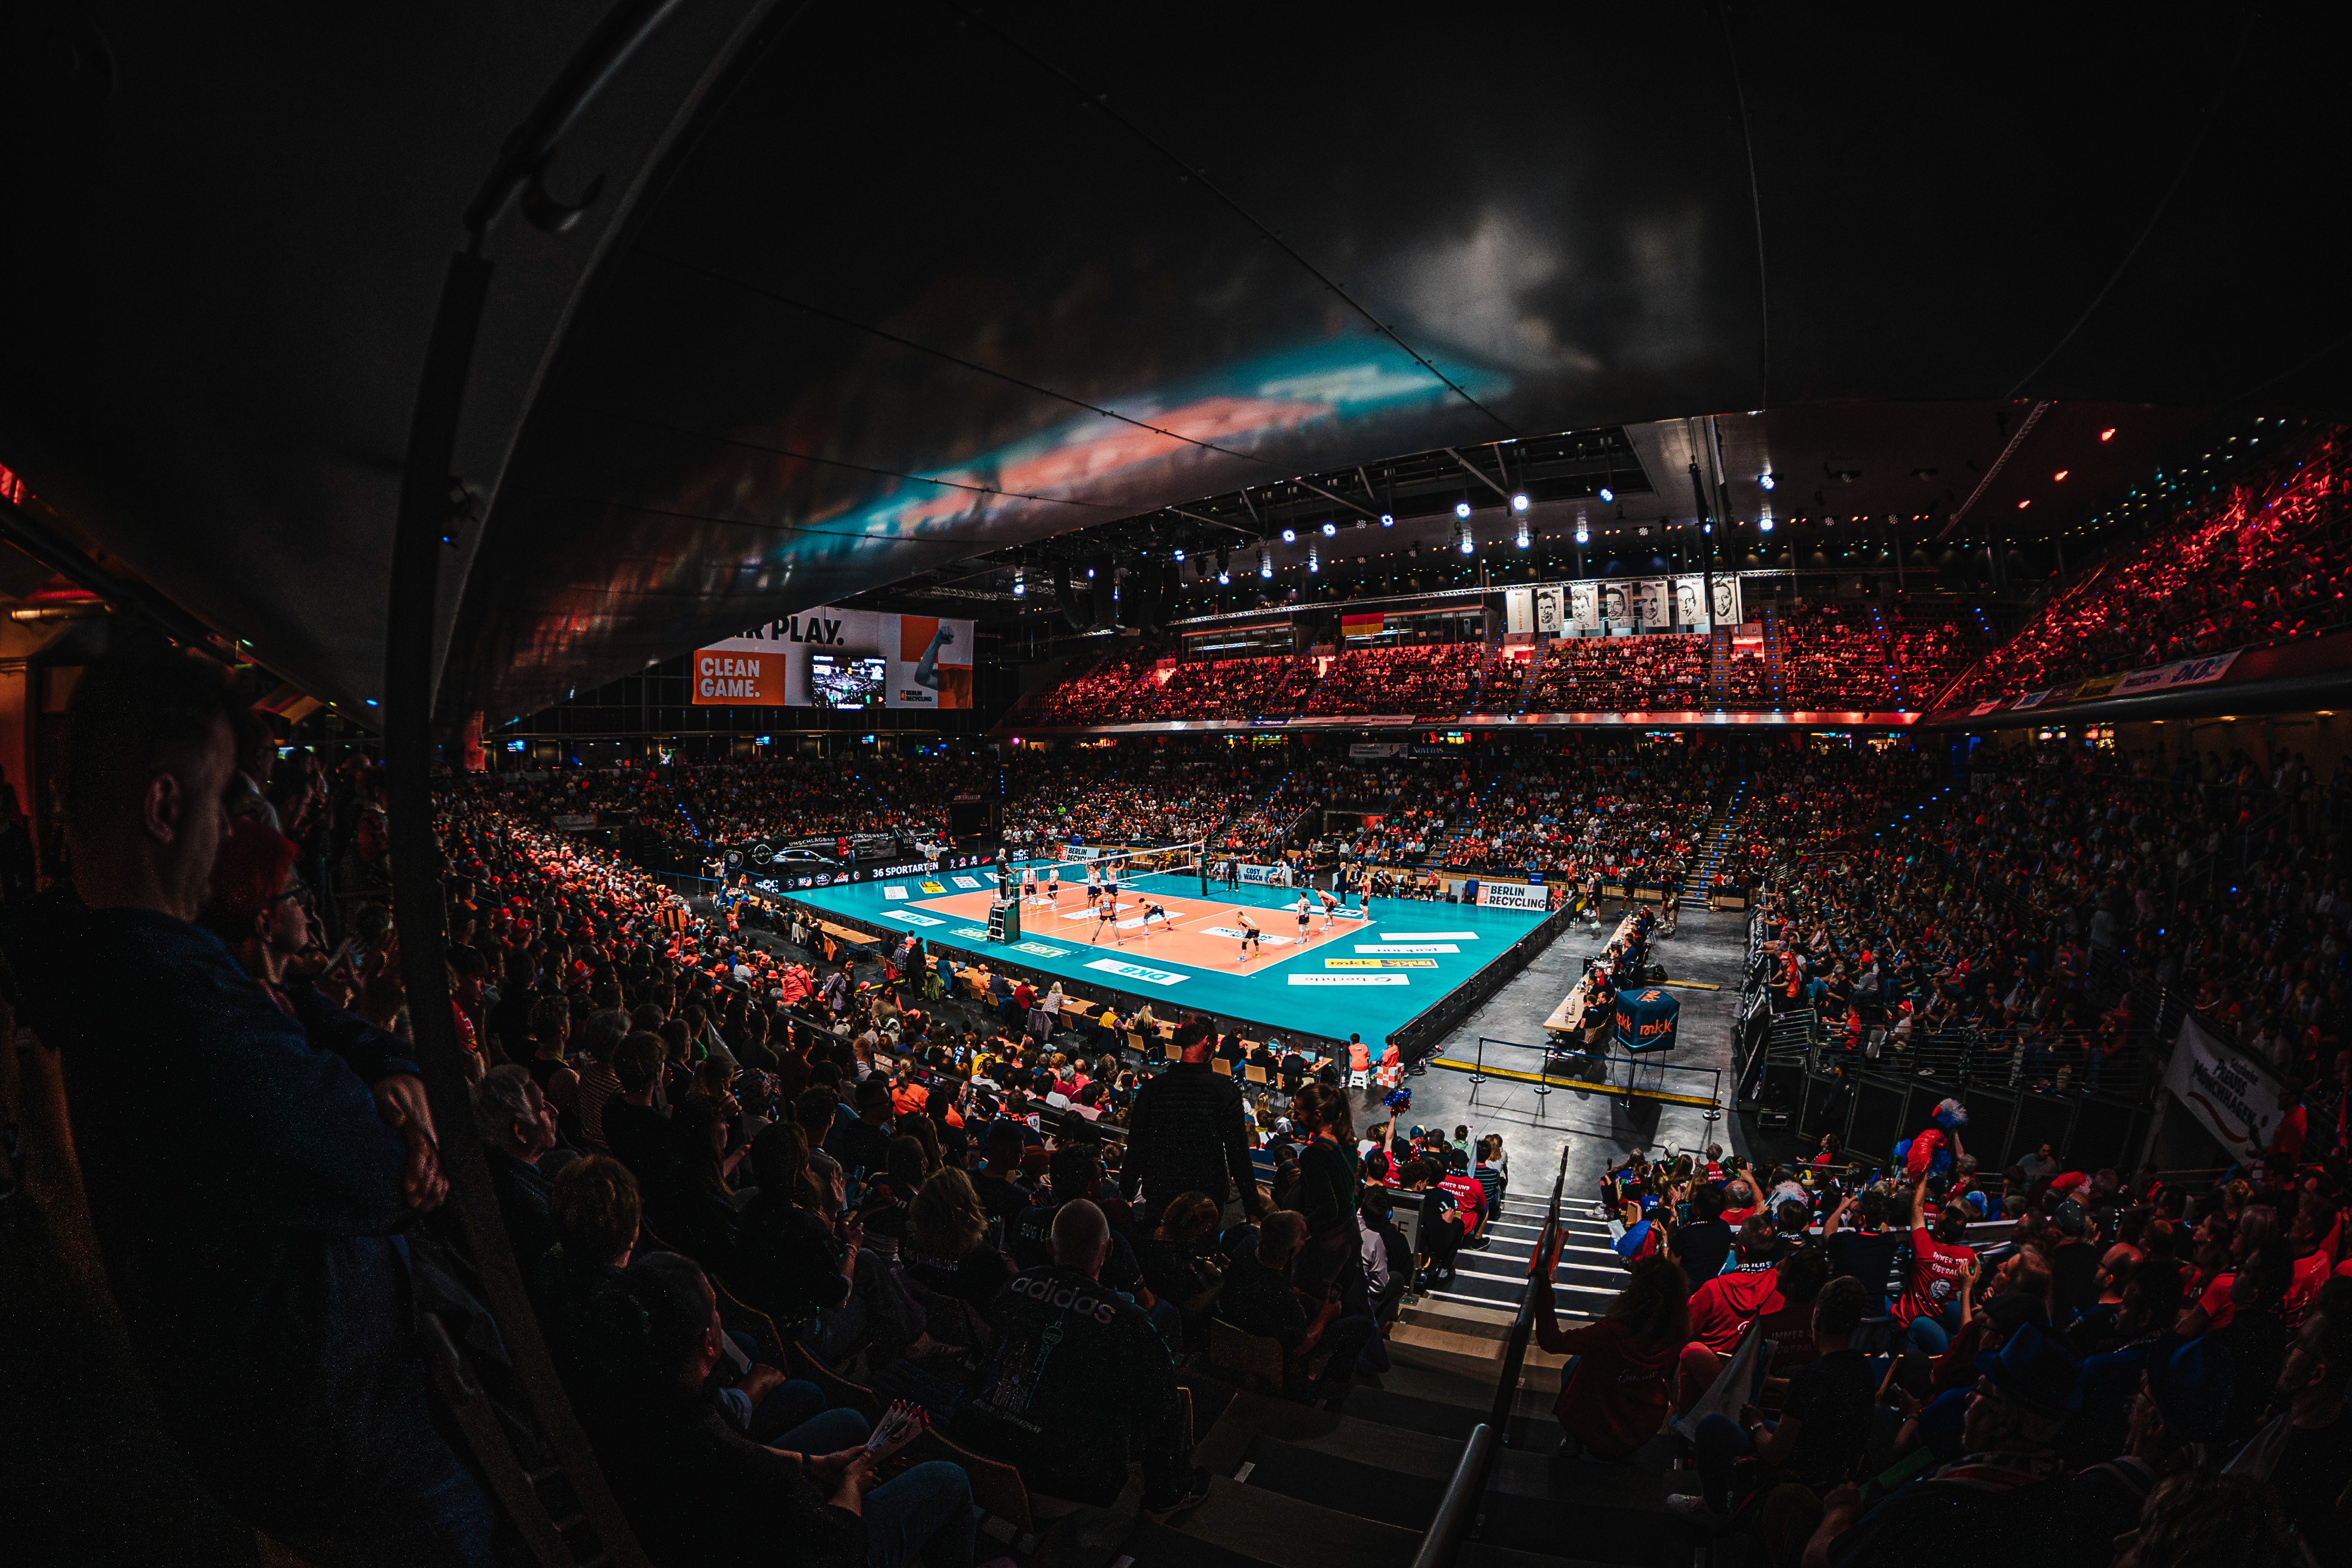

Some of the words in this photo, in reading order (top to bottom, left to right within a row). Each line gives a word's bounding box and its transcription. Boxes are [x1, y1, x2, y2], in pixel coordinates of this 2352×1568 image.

[771, 615, 844, 645] PLAY.
[700, 657, 760, 677] CLEAN
[700, 678, 760, 697] GAME.
[789, 837, 835, 846] UNSCHLAGBAR
[872, 869, 884, 878] 36
[886, 862, 939, 876] SPORTARTEN
[1244, 873, 1263, 881] WASCH
[1246, 867, 1260, 875] COSY
[1490, 885, 1525, 896] BERLIN
[1489, 896, 1546, 908] RECYCLING
[901, 914, 933, 924] DKB
[1020, 942, 1065, 956] LIGO
[1118, 966, 1171, 981] DKB
[1640, 1019, 1673, 1036] mkk
[2212, 1057, 2247, 1097] PREUSS
[2192, 1059, 2256, 1126] MÜNCHHAGEN
[1020, 1223, 1037, 1240] SVG
[1011, 1276, 1117, 1324] adidas
